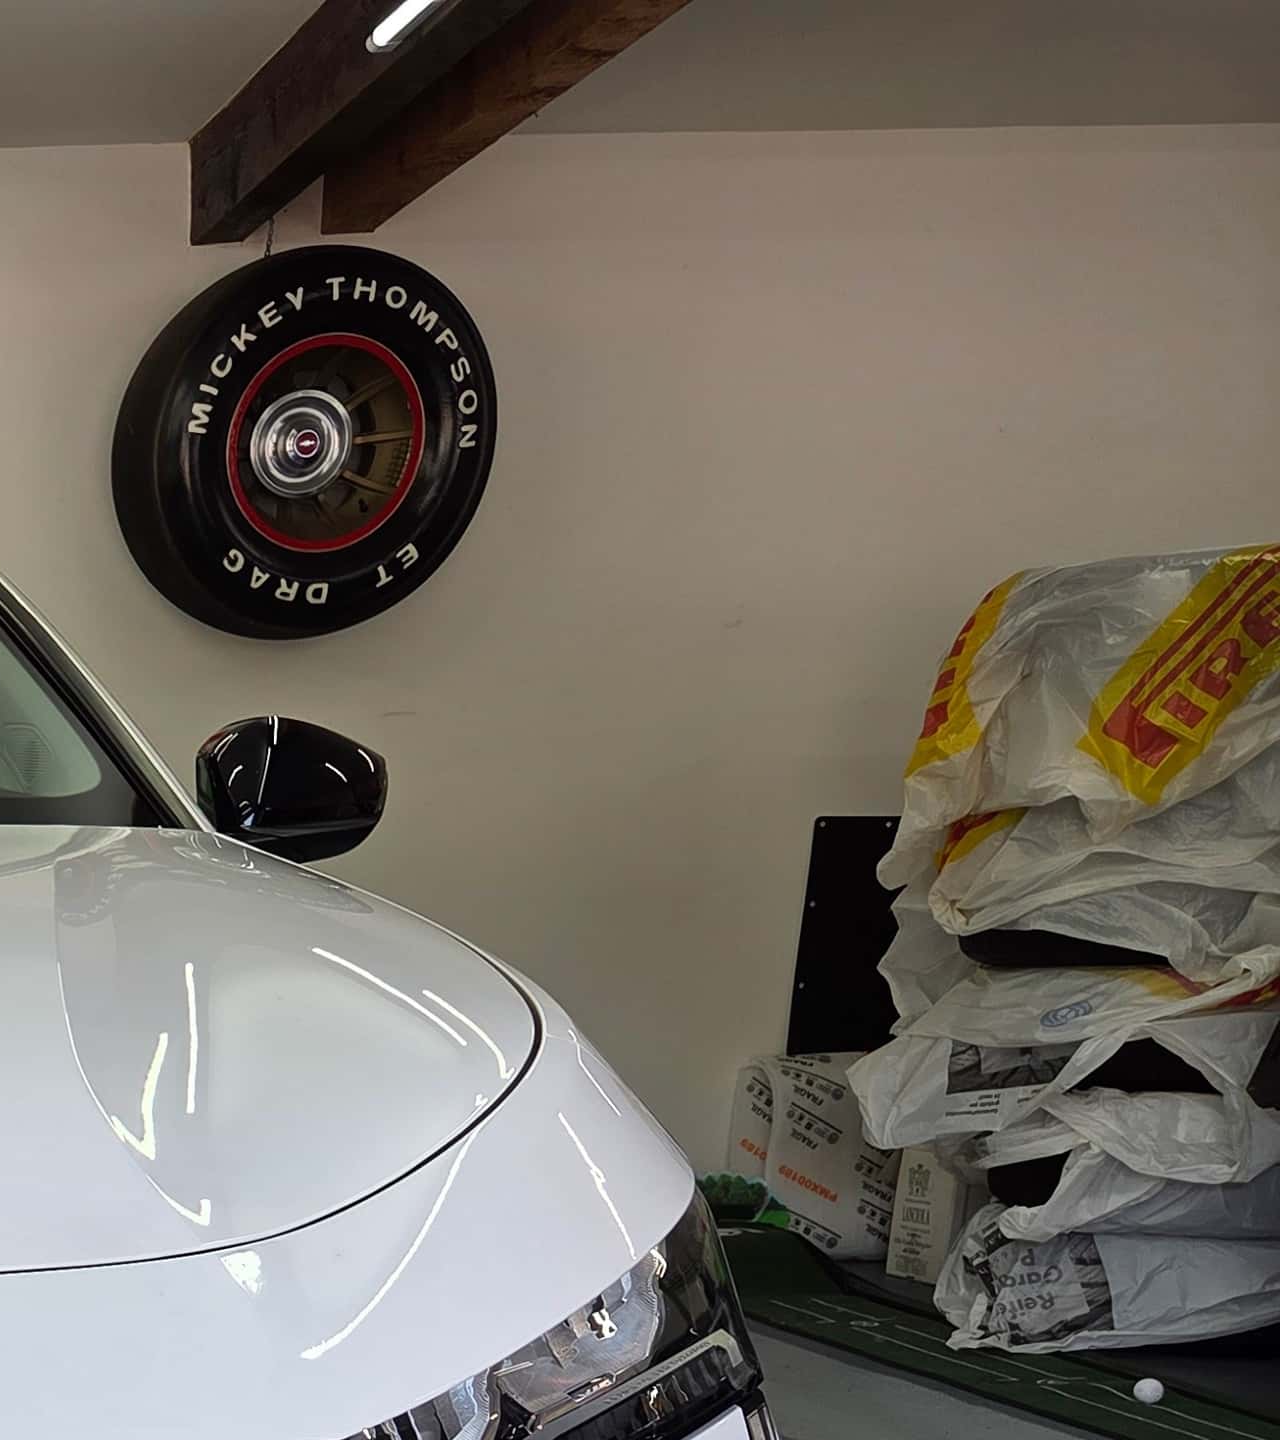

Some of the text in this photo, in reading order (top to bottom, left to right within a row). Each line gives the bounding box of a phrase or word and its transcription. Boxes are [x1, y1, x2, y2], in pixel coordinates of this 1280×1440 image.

[187, 275, 477, 450] MICKEY THOMPSON
[222, 540, 420, 605] ET DRAG
